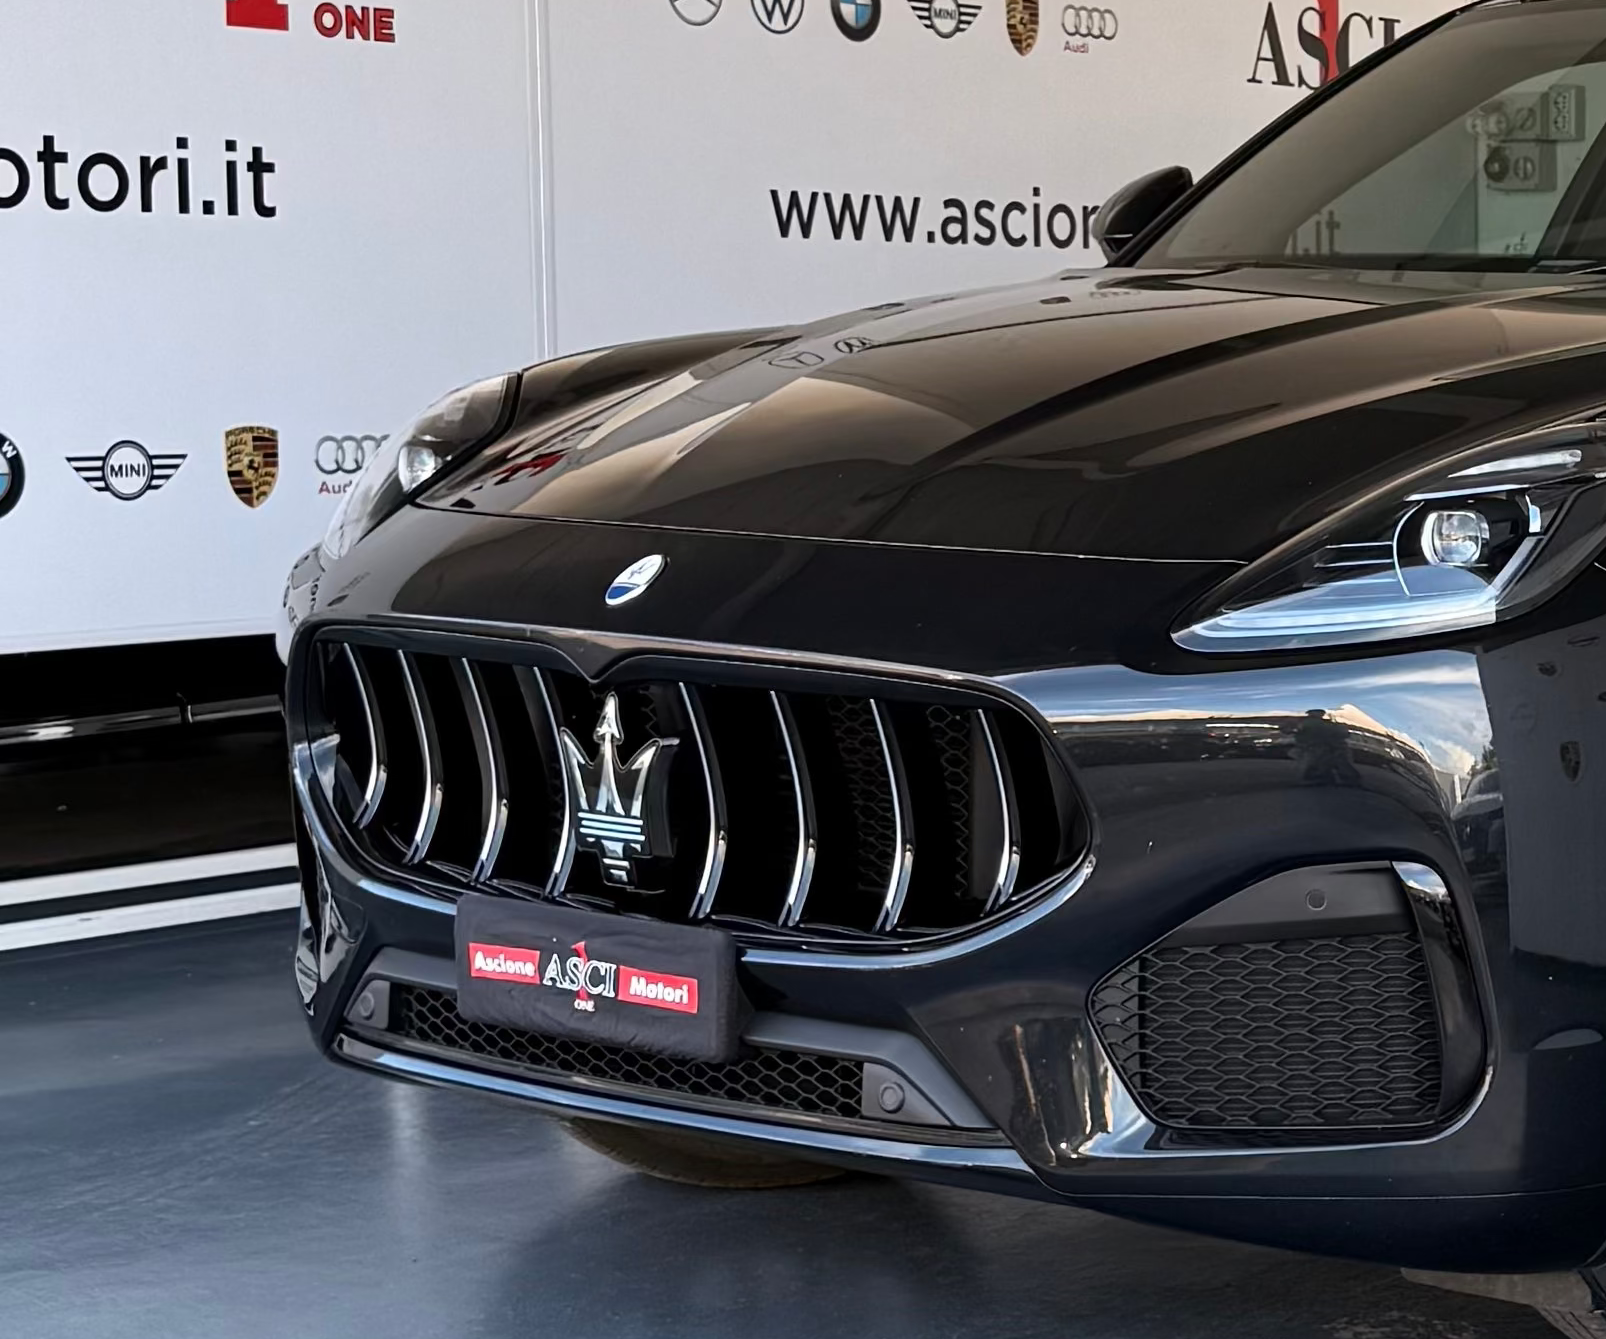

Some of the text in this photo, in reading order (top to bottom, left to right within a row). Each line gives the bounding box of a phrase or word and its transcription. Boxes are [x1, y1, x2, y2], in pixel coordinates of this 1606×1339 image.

[934, 7, 957, 22] MINI
[314, 3, 397, 44] ONE
[1064, 40, 1090, 54] Audi
[109, 463, 146, 479] MINI
[474, 950, 689, 1005] Ascione ASCI Motori
[574, 998, 595, 1012] ONE
